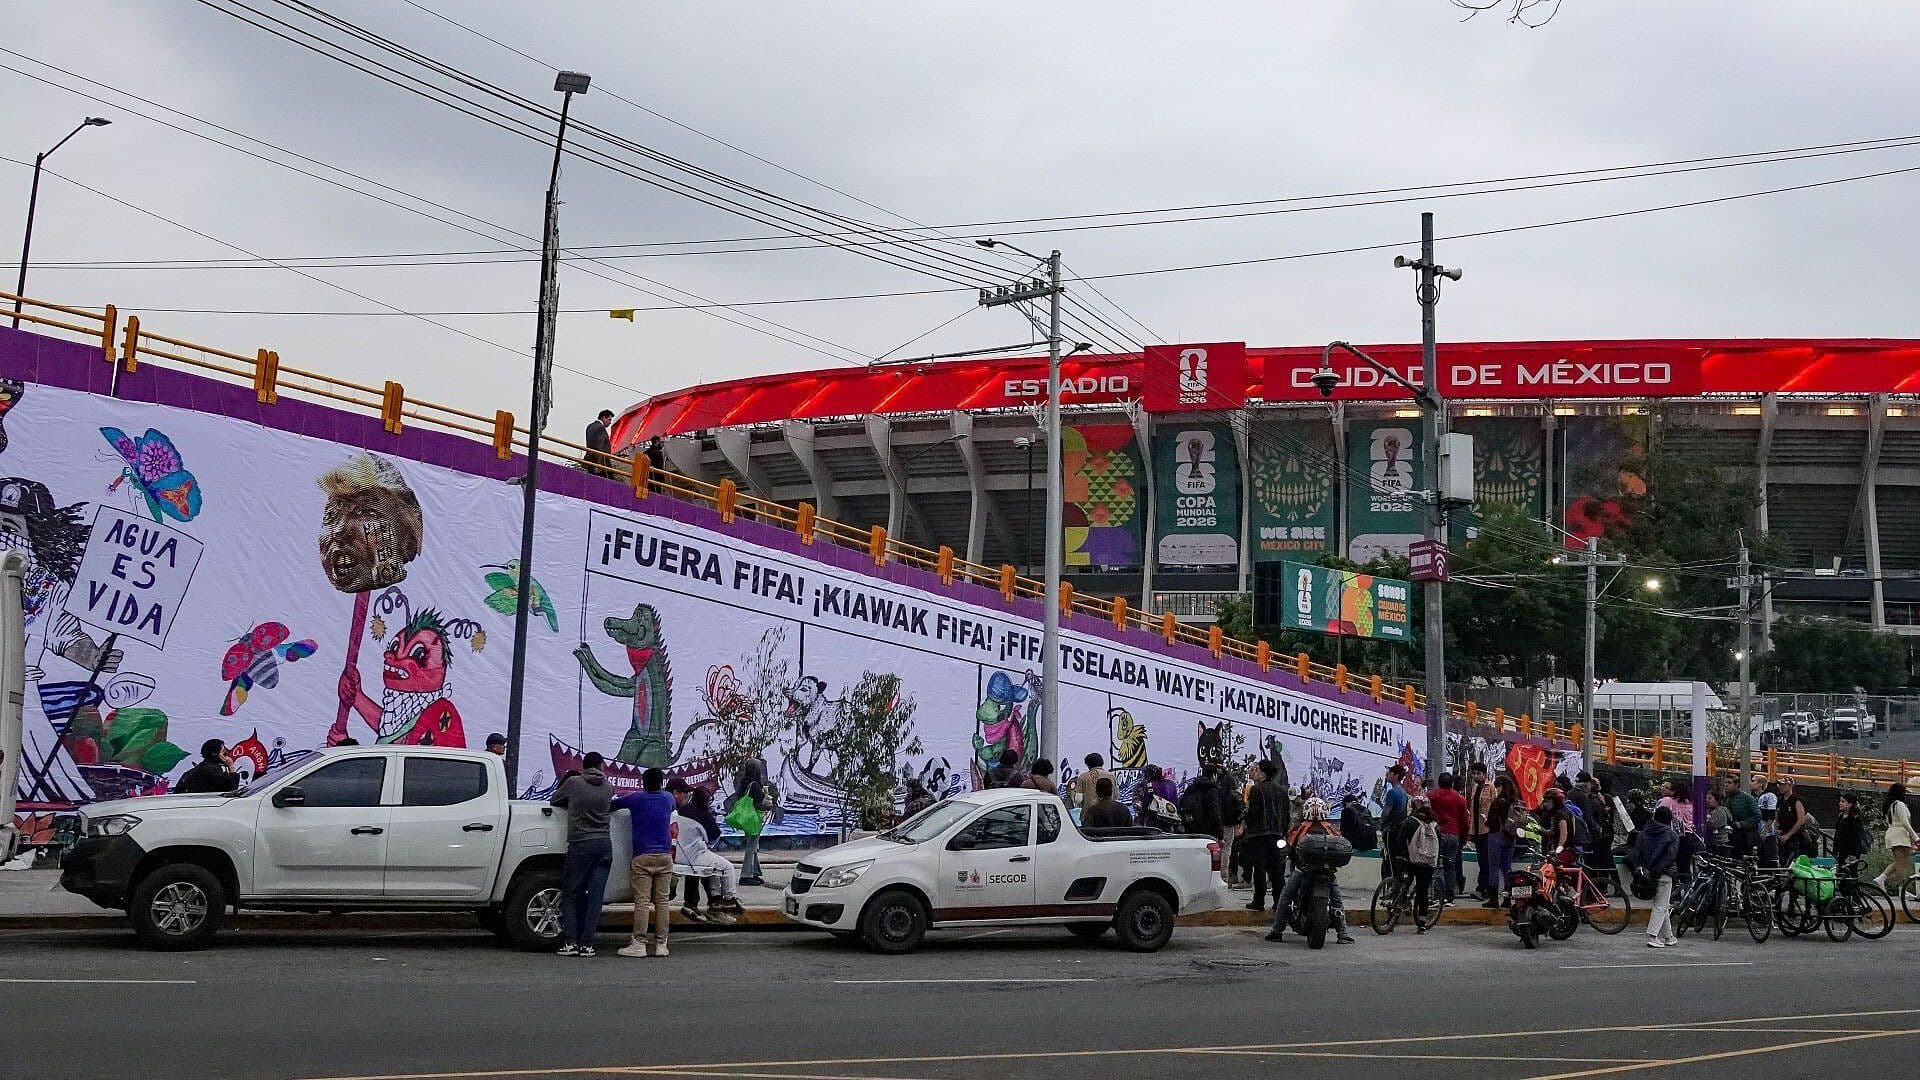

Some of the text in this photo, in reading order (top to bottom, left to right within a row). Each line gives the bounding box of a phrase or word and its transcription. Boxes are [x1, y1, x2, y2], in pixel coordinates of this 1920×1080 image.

[1291, 358, 1671, 388] CUDAD DE MÉXICO
[1004, 375, 1129, 397] ESTADIO
[1187, 481, 1206, 489] FIFA
[1176, 497, 1216, 508] COPA
[1370, 503, 1413, 512] 2026
[1176, 509, 1216, 517] MUNDIAL
[1176, 517, 1217, 527] 2026
[1260, 526, 1325, 539] WE ARE
[104, 518, 178, 568] AGUA
[1303, 541, 1325, 551] CITY
[111, 552, 156, 590] ES
[88, 580, 163, 635] VIDA
[601, 527, 723, 586] ¡FUERA
[733, 560, 805, 606] FIFA!
[813, 583, 929, 637] ¡KIAWAK
[936, 612, 993, 651] FIFA!
[1059, 643, 1149, 689] TSELABA
[1361, 720, 1393, 747] FIFA!
[989, 874, 1027, 883] SECGOB
